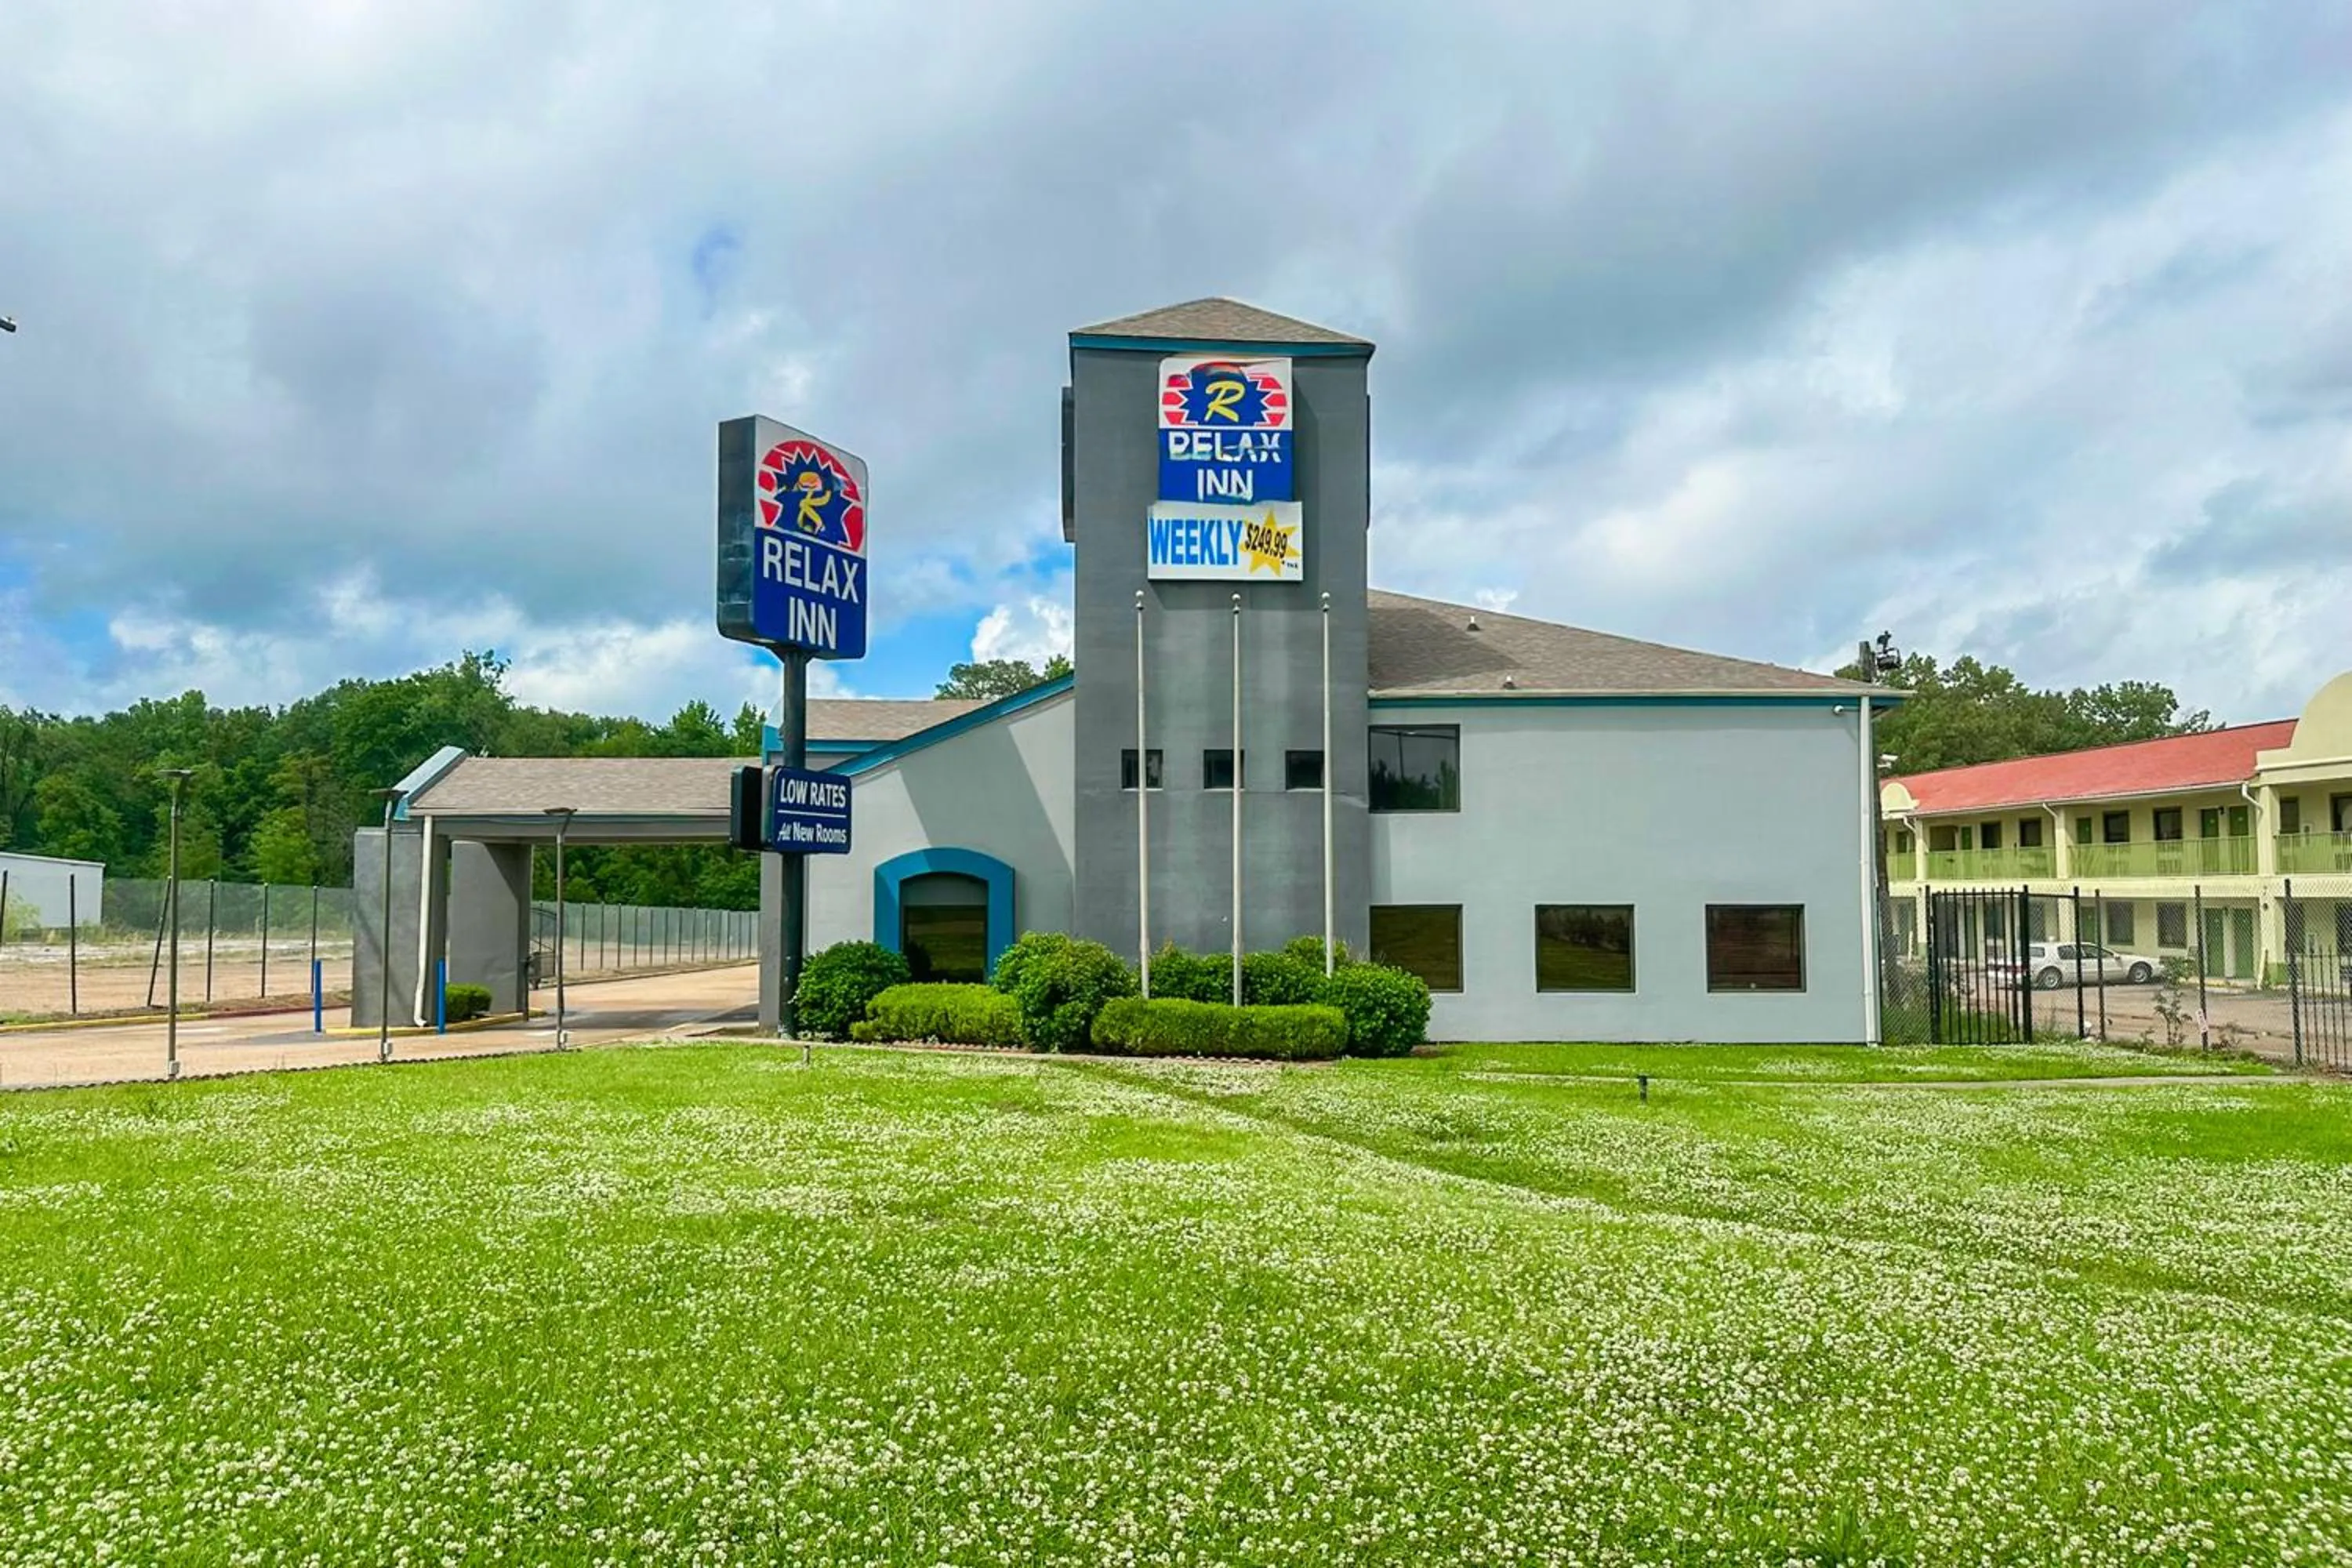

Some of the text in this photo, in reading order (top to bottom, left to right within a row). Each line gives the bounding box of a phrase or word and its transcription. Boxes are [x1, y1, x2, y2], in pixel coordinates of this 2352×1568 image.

[1205, 380, 1245, 423] R
[1168, 431, 1282, 463] RELAX
[1197, 469, 1254, 502] INN
[1149, 516, 1288, 565] WEEKLY $249.99
[763, 535, 859, 604] RELAX
[789, 596, 837, 650] INN
[780, 778, 846, 808] LOW RATES
[793, 821, 814, 843] New
[816, 822, 847, 844] Rooms
